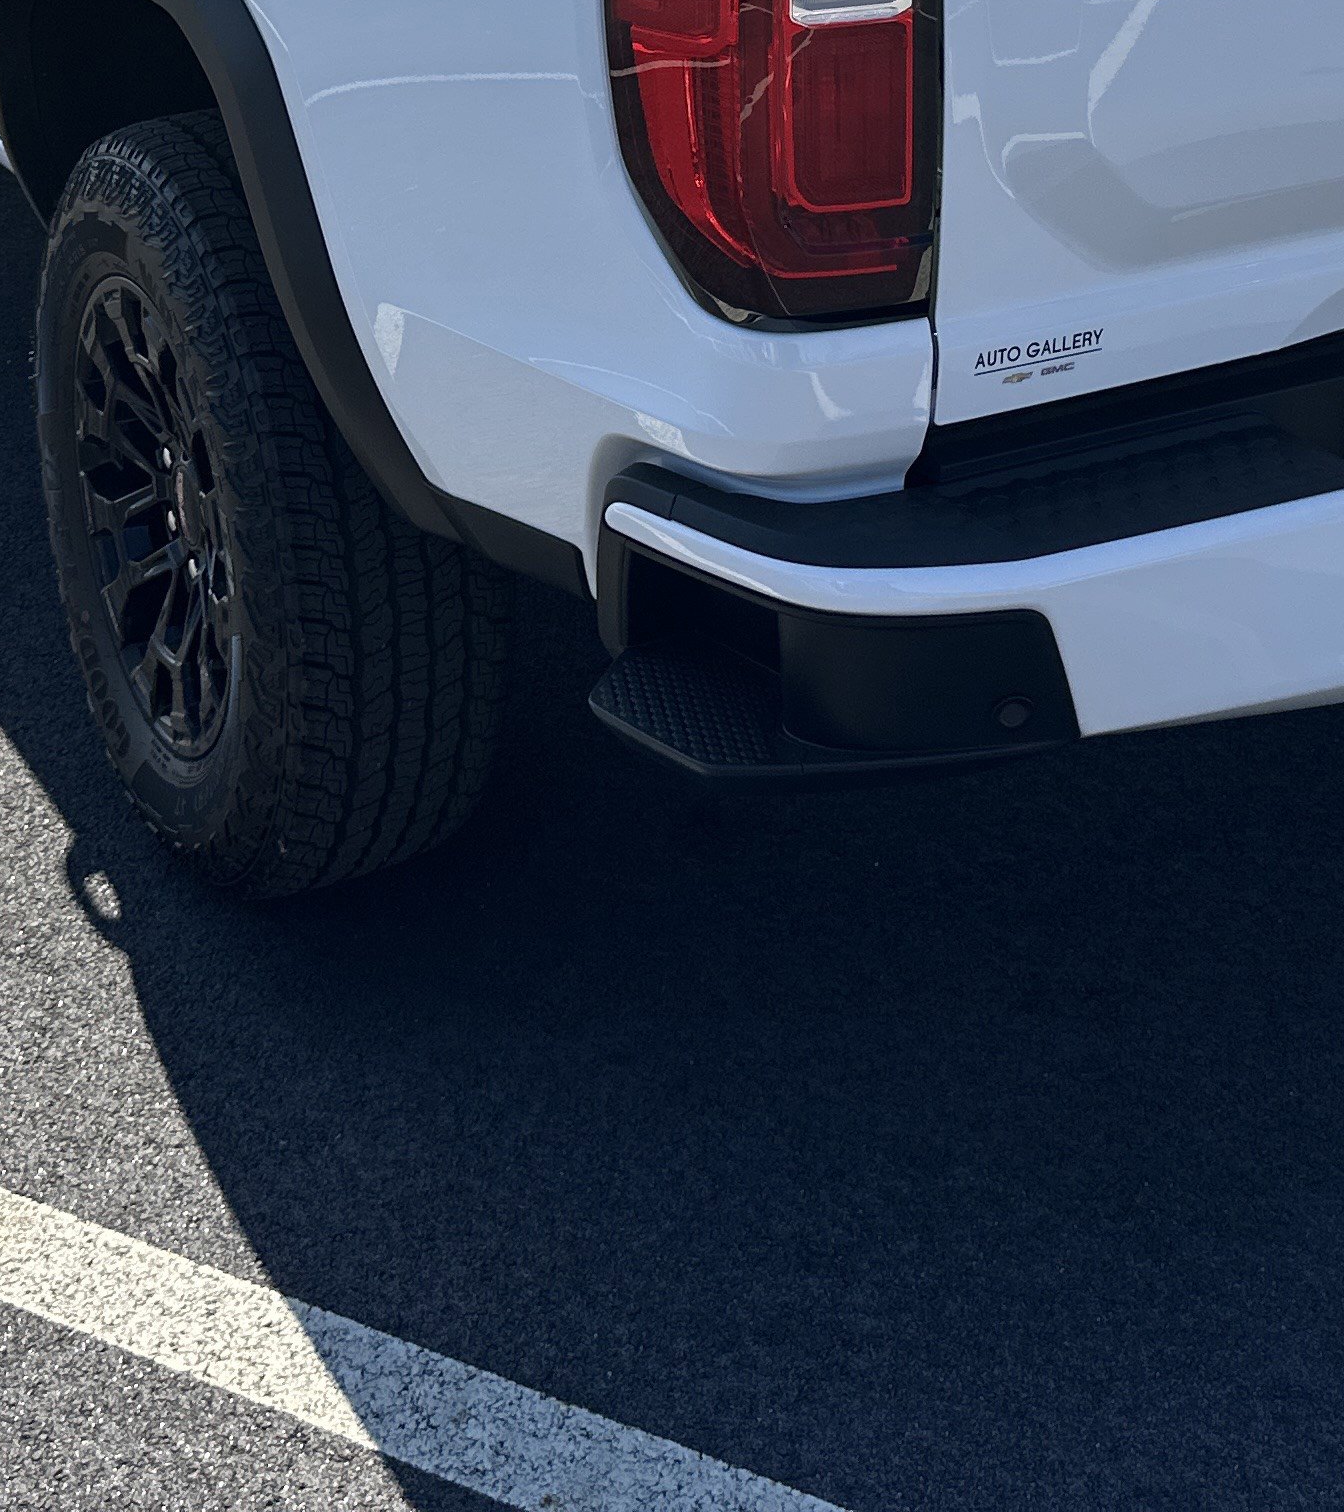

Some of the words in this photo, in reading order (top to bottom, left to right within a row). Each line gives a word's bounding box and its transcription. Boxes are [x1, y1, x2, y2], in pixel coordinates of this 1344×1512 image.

[975, 346, 1021, 369] AUTO
[1027, 329, 1104, 358] GALLERY
[1040, 362, 1075, 376] GMC
